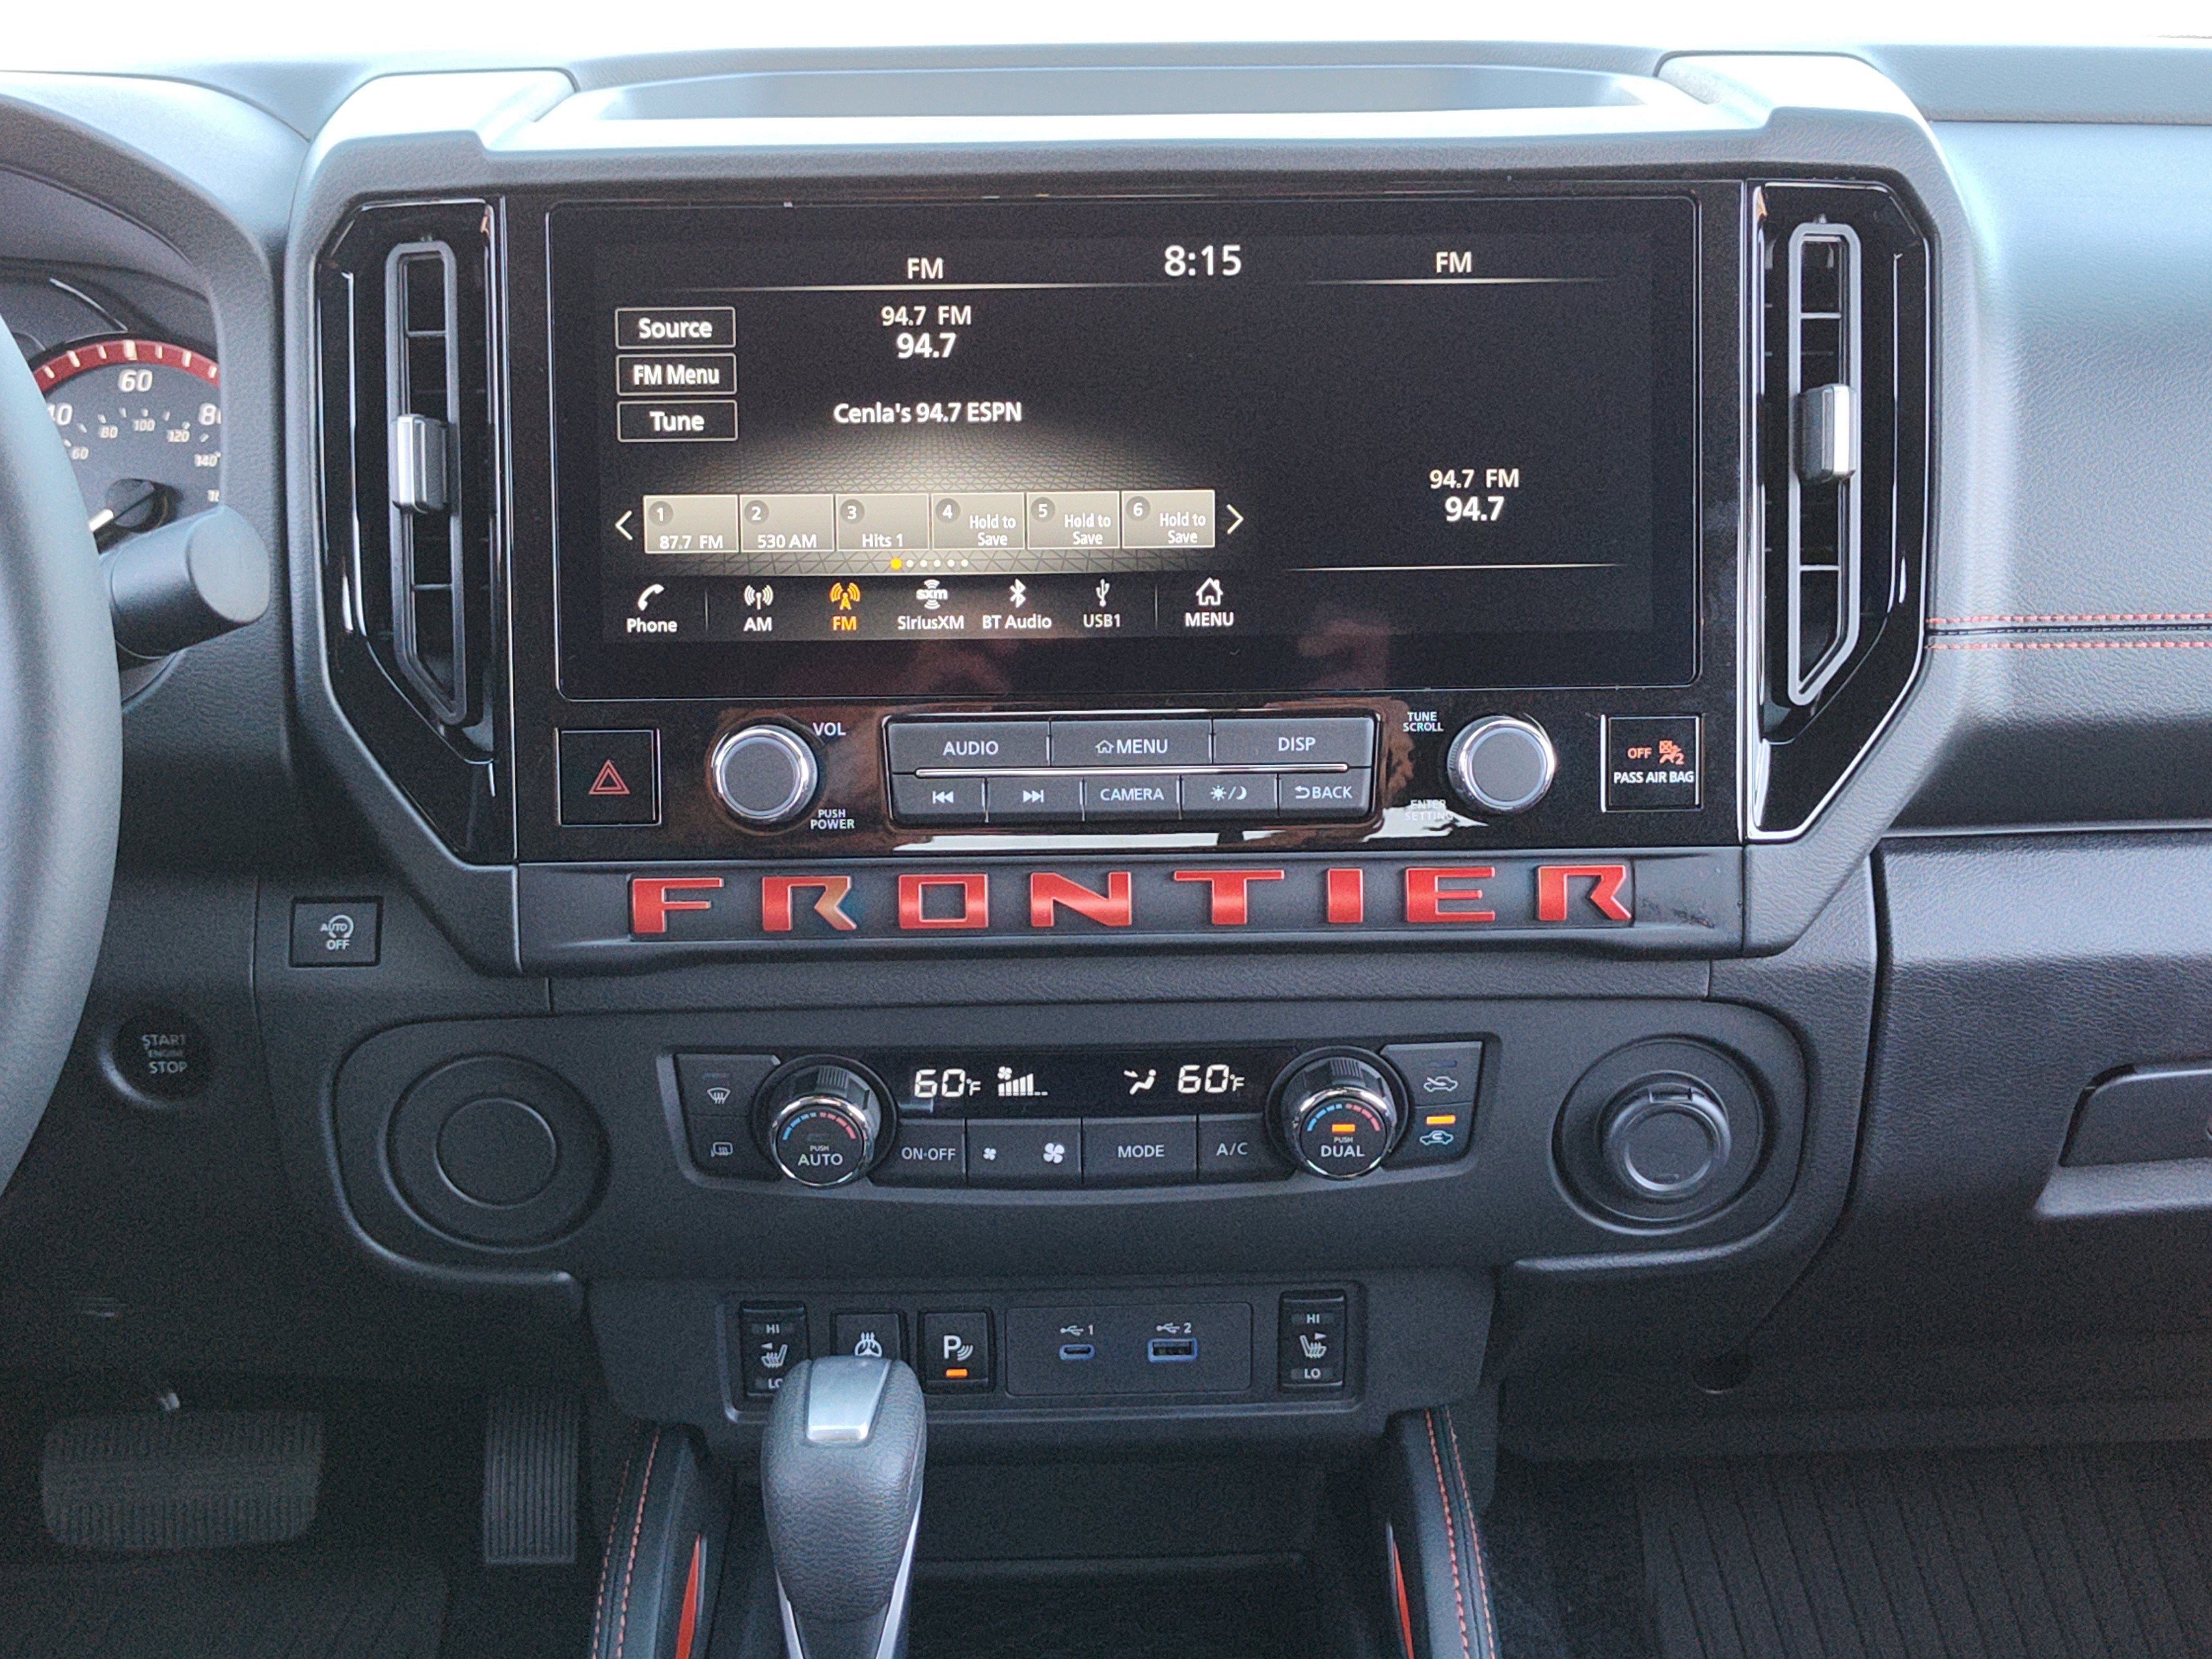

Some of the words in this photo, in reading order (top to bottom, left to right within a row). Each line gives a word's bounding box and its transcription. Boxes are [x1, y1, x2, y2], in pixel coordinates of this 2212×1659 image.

[1164, 245, 1242, 276] 8:15
[1435, 252, 1472, 273] FM
[907, 258, 943, 279] FM
[882, 306, 926, 326] 94.7
[938, 305, 972, 325] FM
[639, 318, 712, 339] Source
[897, 332, 957, 358] 94.7
[118, 369, 153, 392] 60
[633, 365, 662, 385] FM
[667, 365, 719, 385] Menu
[199, 403, 221, 426] 8
[834, 403, 911, 423] Cenla's
[916, 403, 960, 422] 94.7
[967, 402, 1022, 422] ESPN
[133, 419, 155, 431] 100
[650, 412, 704, 431] Tune
[100, 425, 118, 438] 80
[167, 430, 190, 443] 120
[71, 447, 89, 460] 60
[194, 454, 218, 467] 140
[1429, 470, 1474, 489] 94.7
[1486, 469, 1520, 488] FM
[657, 508, 664, 521] 1
[752, 507, 761, 520] 2
[847, 505, 857, 519] 3
[942, 505, 953, 518] 4
[1038, 504, 1048, 517] 5
[1134, 503, 1143, 516] 6
[1445, 496, 1505, 521] 94.7
[970, 515, 1000, 529] Hold
[1003, 517, 1016, 529] to
[1064, 514, 1095, 528] Hold
[1097, 515, 1111, 527] to
[1159, 512, 1190, 527] Hold
[1193, 514, 1206, 527] to
[659, 535, 691, 549] 87.7
[700, 535, 724, 549] FM
[758, 535, 785, 548] 530
[789, 535, 817, 548] AM
[862, 534, 892, 547] Hits
[896, 534, 903, 547] 1
[978, 533, 1008, 546] Save
[1073, 531, 1103, 545] Save
[1168, 530, 1198, 544] Save
[627, 618, 677, 632] Phone
[744, 617, 772, 631] AM
[833, 617, 857, 631] FM
[898, 615, 963, 630] SiriusXM
[982, 615, 1002, 629] BT
[1005, 614, 1052, 629] Audio
[1083, 613, 1121, 628] USB1
[1185, 612, 1234, 626] MENU
[1407, 712, 1437, 721] TUNE
[812, 722, 847, 736] VOL
[1403, 723, 1444, 732] SCROLL
[942, 740, 999, 756] AUDIO
[1117, 739, 1168, 754] MENU
[1278, 737, 1316, 752] DISP
[1627, 747, 1652, 759] OFF
[1614, 772, 1643, 783] PASS
[1645, 772, 1667, 783] AIR
[1669, 771, 1694, 783] BAG
[1100, 788, 1164, 801] CAMERA
[1312, 786, 1352, 799] BACK
[818, 810, 846, 818] PUSH
[811, 819, 854, 830] POWER
[632, 865, 1632, 933] FRONTIER
[327, 939, 350, 950] OFF
[141, 1034, 186, 1047] START
[149, 1061, 187, 1074] STOP
[1118, 1145, 1164, 1158] MODE
[1216, 1143, 1248, 1156] A/C
[1321, 1145, 1365, 1158] DUAL
[798, 1154, 843, 1166] AUTO
[1306, 1314, 1320, 1324] HI
[766, 1324, 779, 1334] HI
[1088, 1325, 1094, 1335] 1
[1184, 1323, 1192, 1333] 2
[1304, 1369, 1321, 1379] LO
